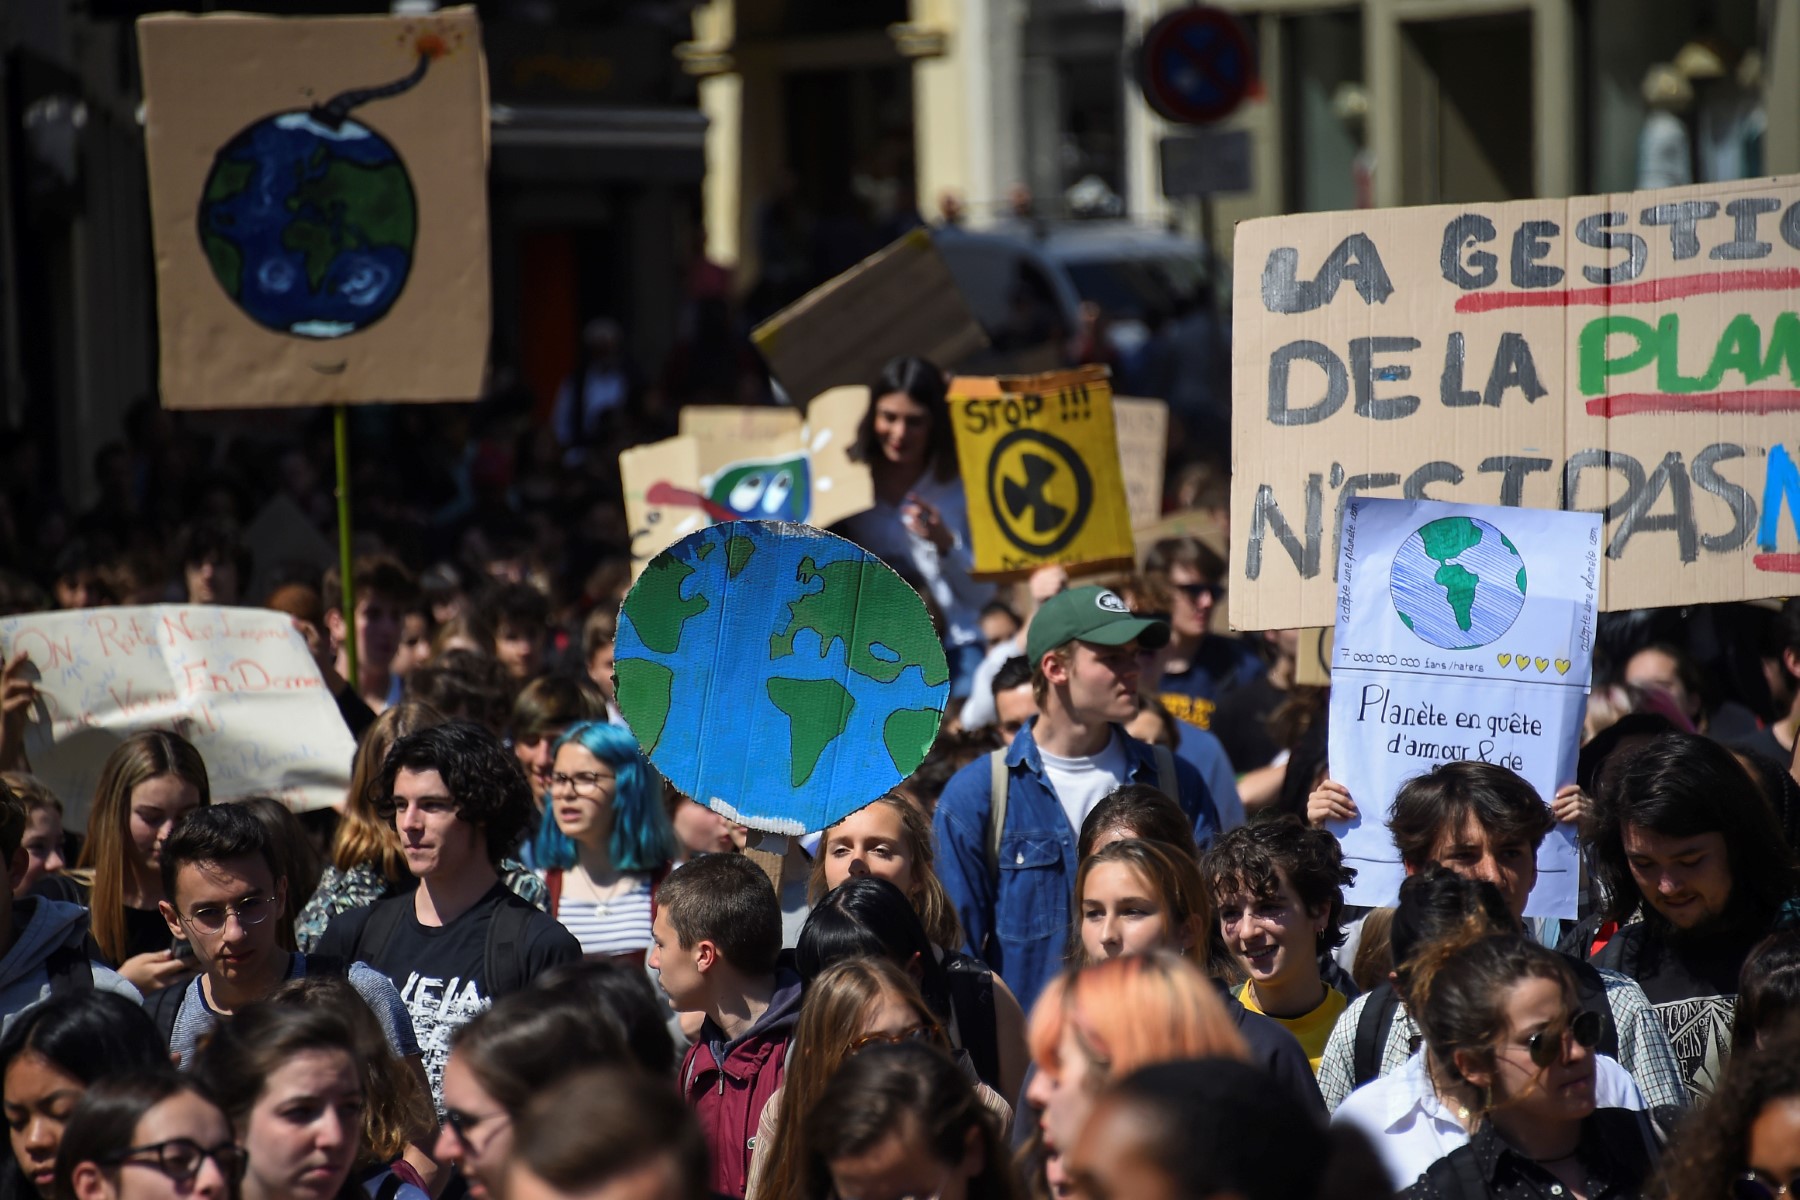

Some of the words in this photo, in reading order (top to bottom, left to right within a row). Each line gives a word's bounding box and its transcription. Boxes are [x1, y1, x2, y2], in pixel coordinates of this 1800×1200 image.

[1262, 232, 1394, 314] LA
[1267, 336, 1421, 426] DE
[1440, 331, 1549, 407] LA
[964, 393, 1043, 436] STOP
[1059, 384, 1091, 422] !!!
[1558, 442, 1759, 567] PAS
[1344, 562, 1352, 583] une
[1424, 657, 1447, 669] fans
[1357, 684, 1448, 727] Planète
[1455, 711, 1481, 729] en
[1486, 712, 1542, 738] quête
[1387, 732, 1471, 762] d'amour
[1476, 740, 1495, 764] &
[1500, 751, 1524, 771] de
[1675, 1022, 1702, 1060] CETS
